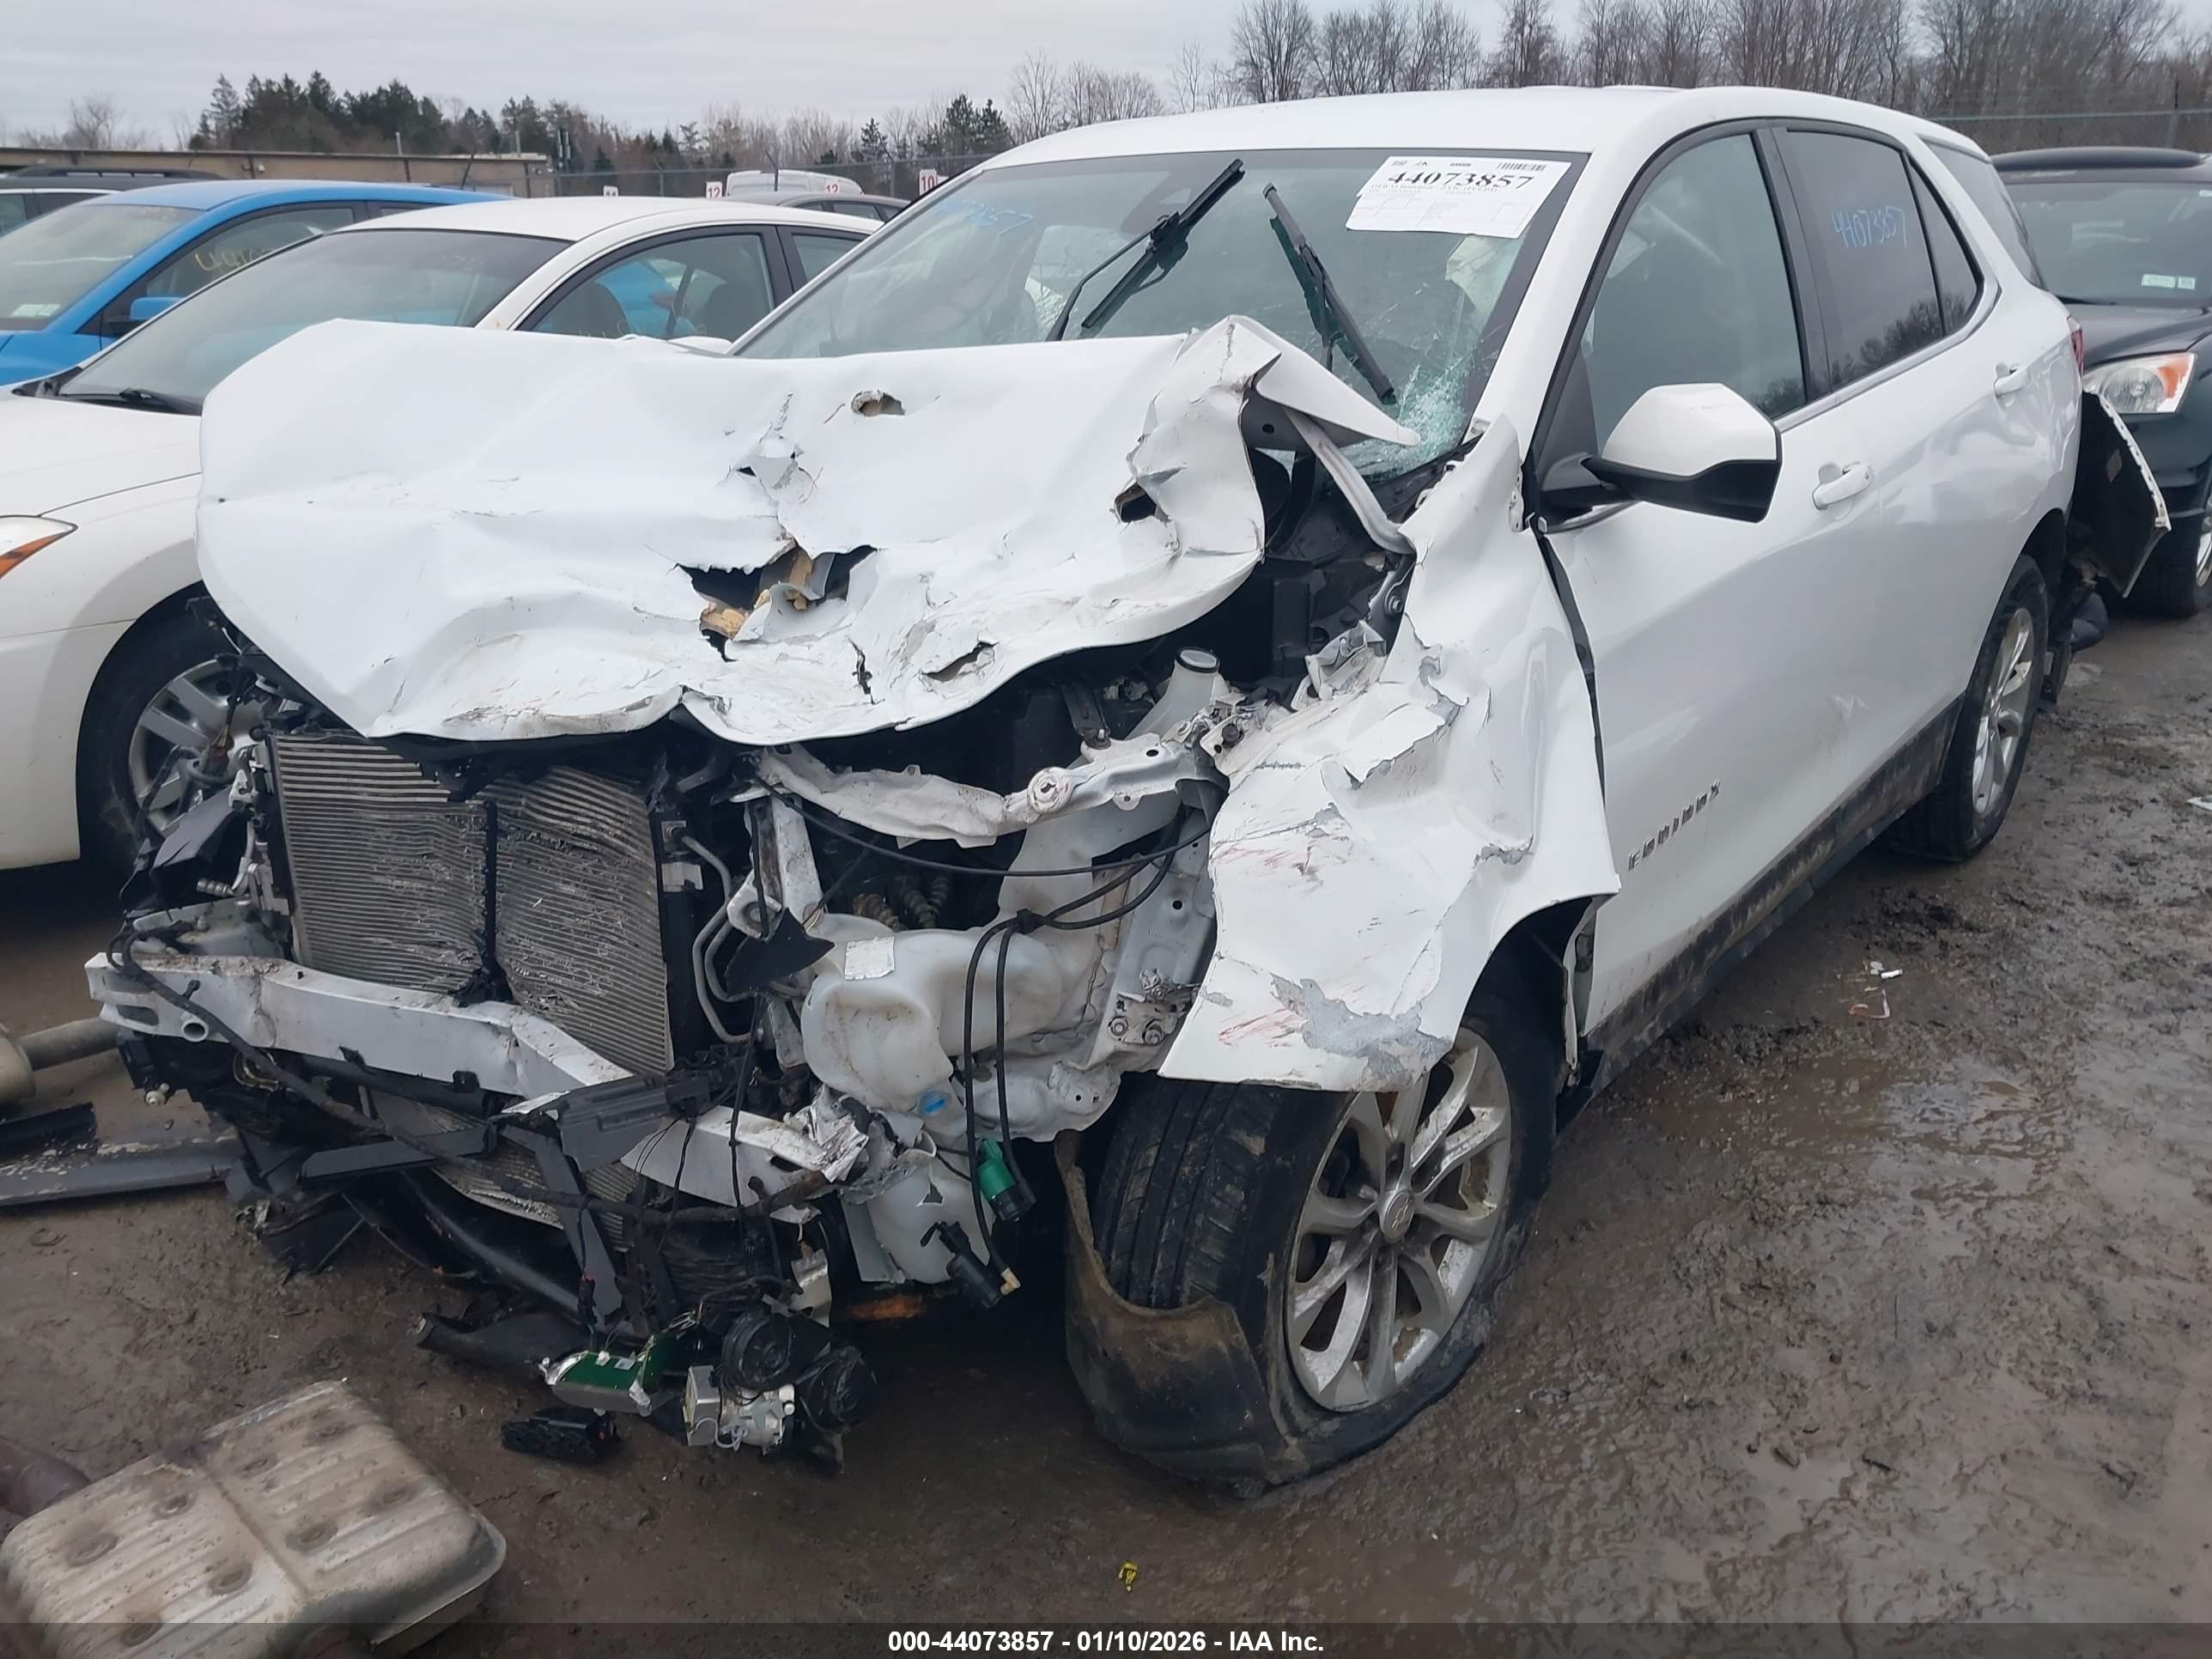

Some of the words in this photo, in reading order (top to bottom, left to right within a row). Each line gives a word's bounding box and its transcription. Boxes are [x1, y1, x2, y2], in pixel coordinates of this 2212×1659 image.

[921, 175, 935, 192] 10
[1388, 172, 1535, 189] 44073857
[1830, 205, 1908, 248] 44073857
